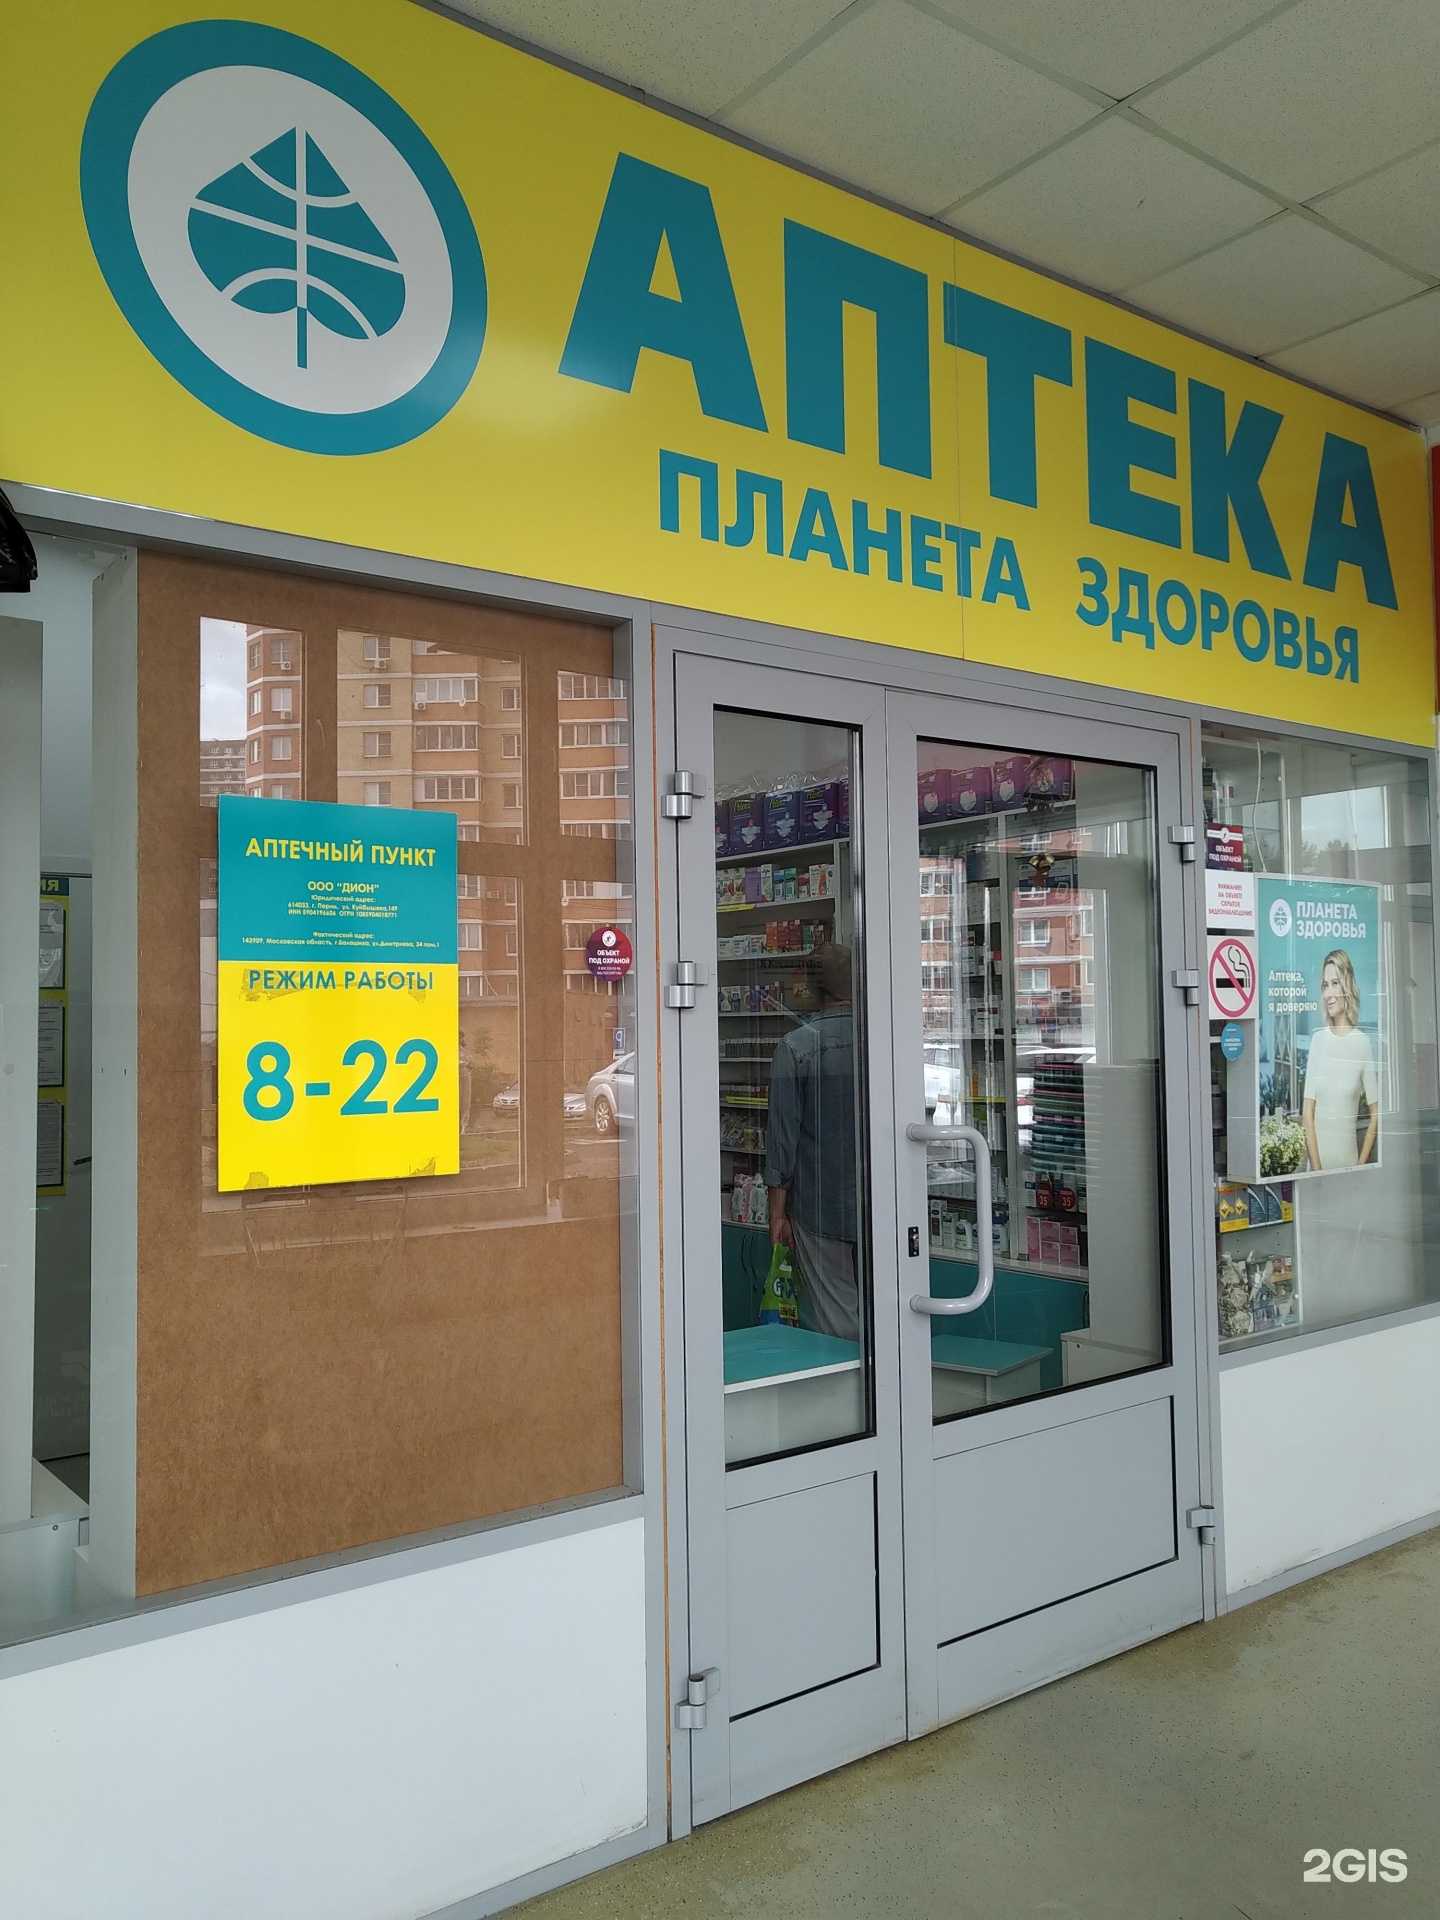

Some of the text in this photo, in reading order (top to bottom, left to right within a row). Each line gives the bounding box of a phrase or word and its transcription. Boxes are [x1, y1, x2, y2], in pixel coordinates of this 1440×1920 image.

[558, 152, 1399, 610] АПТЕКА
[659, 448, 1360, 684] ПЛАНЕТА ЗДОРОВЬЯ
[245, 838, 436, 868] АПТЕЧНЫЙ ПУНКТ
[307, 880, 380, 894] ООО "ДИОН"
[1296, 901, 1358, 920] ПЛАНЕТА
[1296, 921, 1366, 940] ЗДОРОВЬЯ
[588, 956, 630, 965] ПОД ОХРАНОЙ
[596, 949, 620, 957] ОБЪЕКТ
[248, 969, 433, 991] РЕЖИМ РАБОТЫ
[1268, 969, 1305, 983] Аптека,
[1268, 985, 1307, 998] которой
[1268, 1003, 1318, 1014] я доверяю
